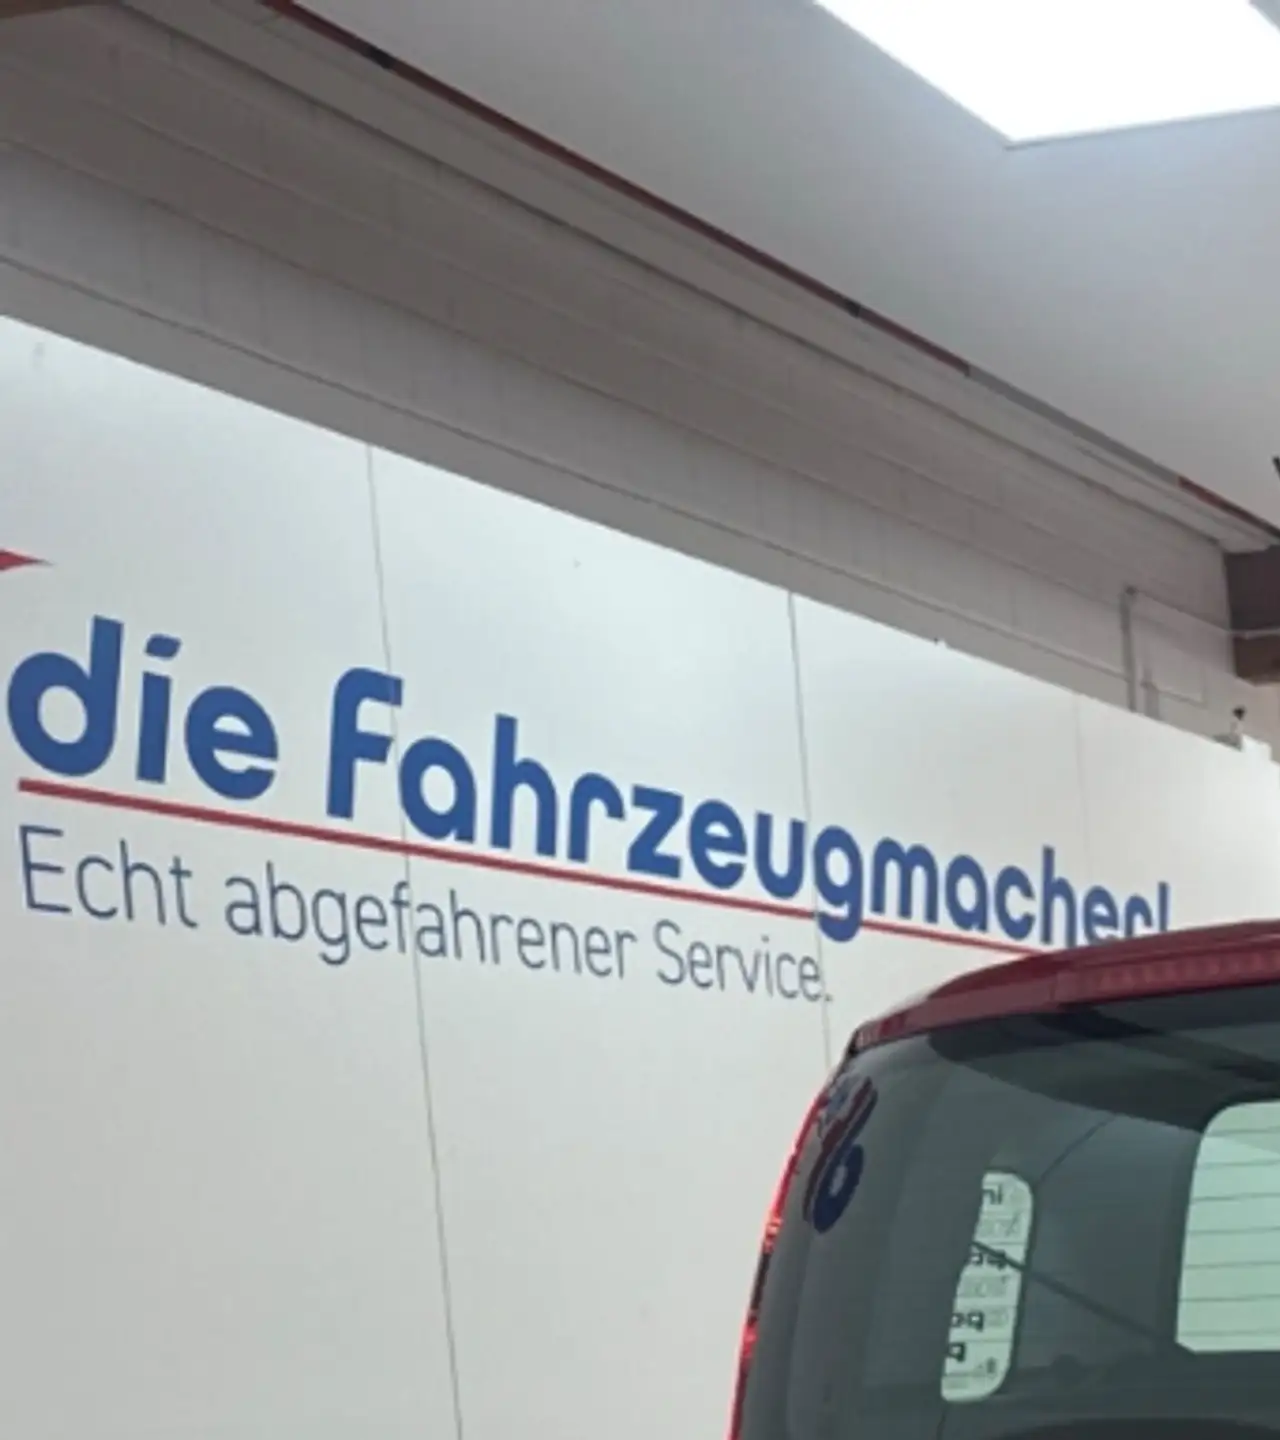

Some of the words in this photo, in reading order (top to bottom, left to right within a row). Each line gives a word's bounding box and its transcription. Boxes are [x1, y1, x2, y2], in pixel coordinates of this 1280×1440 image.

[8, 615, 278, 800] die
[19, 824, 197, 929] Echt
[225, 861, 637, 978] abgefahrener
[655, 919, 832, 1002] Service.
